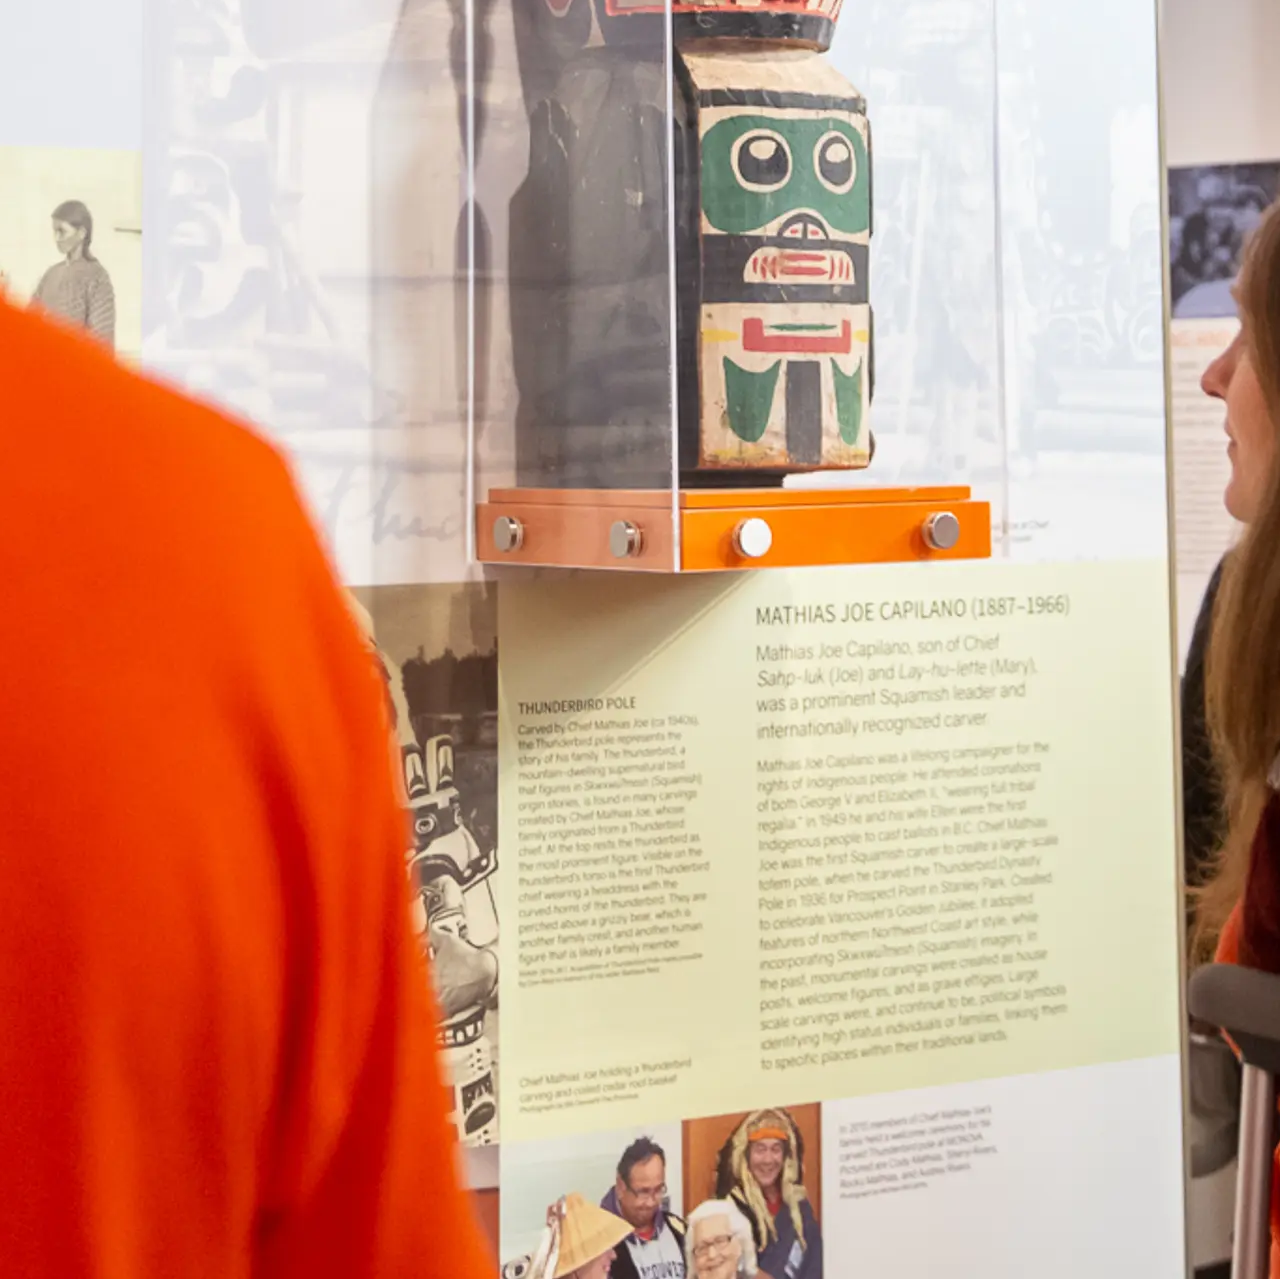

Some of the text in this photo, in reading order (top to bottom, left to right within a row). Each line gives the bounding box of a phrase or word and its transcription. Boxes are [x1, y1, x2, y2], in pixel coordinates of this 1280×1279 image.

[755, 596, 1070, 625] MATHIAS JOE CAPILANO (1887–1966)
[757, 643, 814, 661] Mathias
[817, 642, 843, 658] Joe
[916, 642, 943, 654] son
[945, 637, 960, 653] of
[962, 635, 999, 652] Chief
[828, 665, 864, 685] (Joe)
[866, 664, 895, 680] and
[518, 697, 636, 714] THUNDERBIRD POLE
[757, 682, 1026, 714] was a prominent Squamish leader and
[757, 717, 859, 744] internationally
[862, 712, 941, 737] recognized
